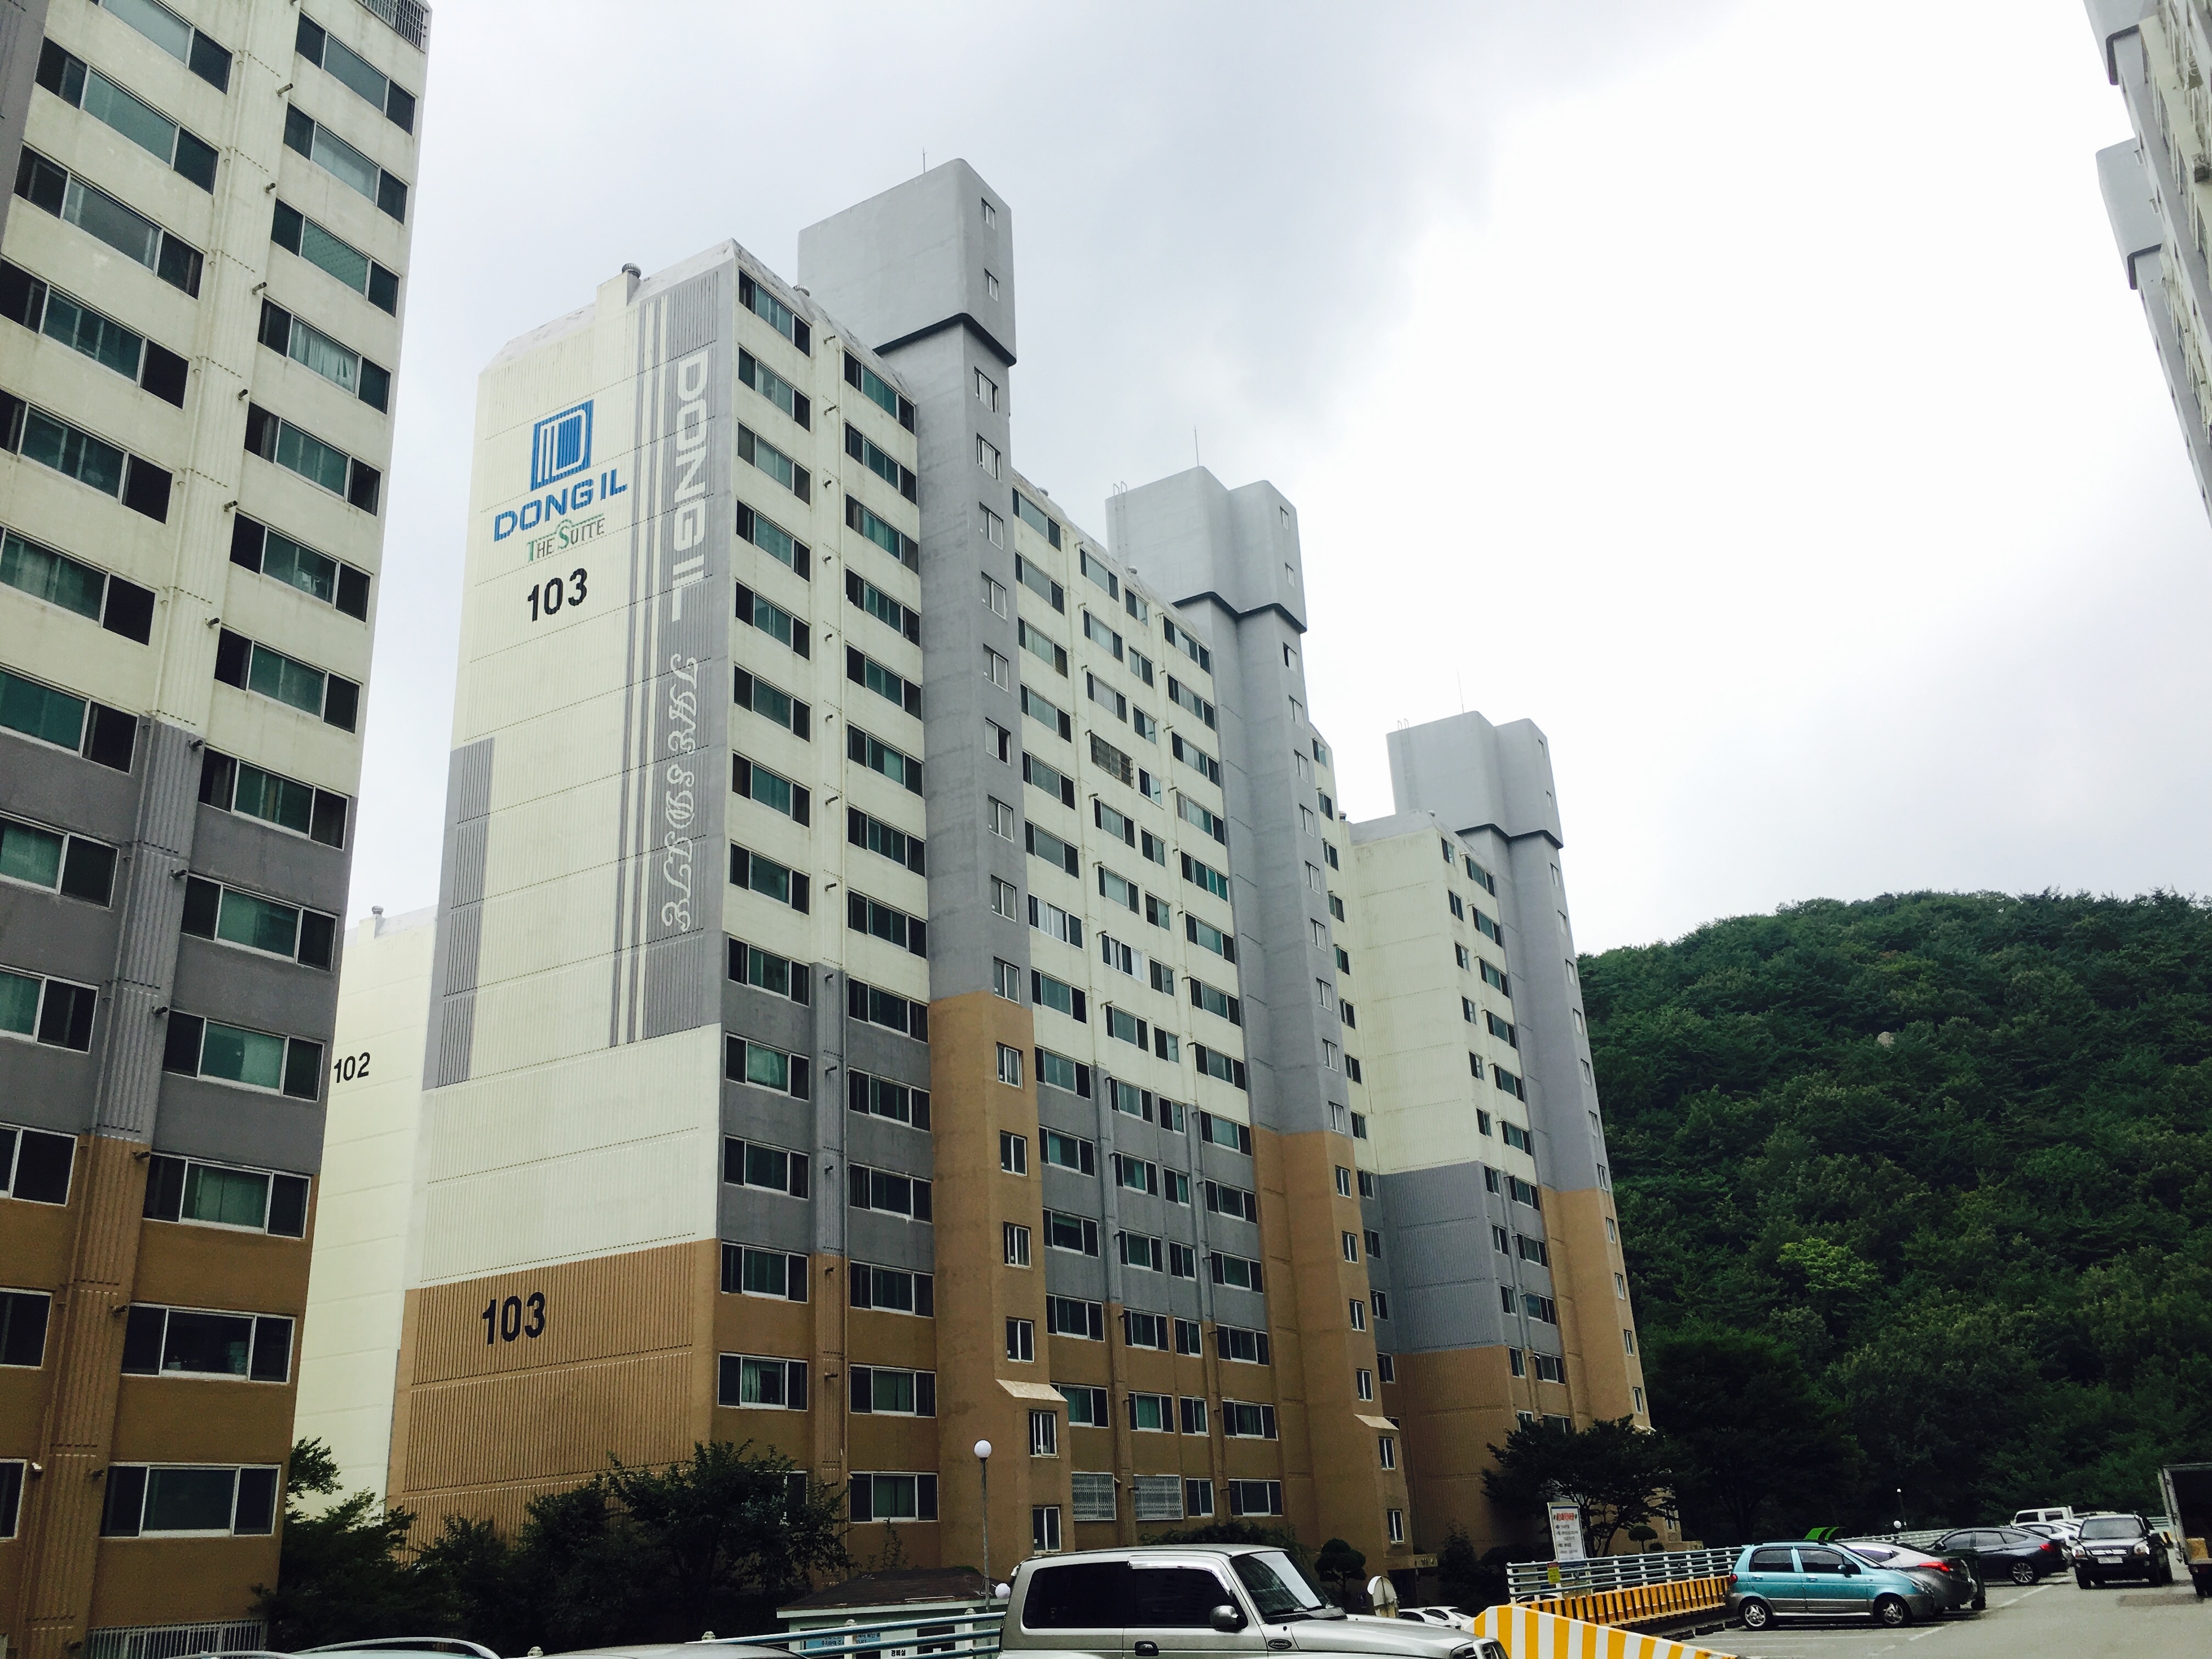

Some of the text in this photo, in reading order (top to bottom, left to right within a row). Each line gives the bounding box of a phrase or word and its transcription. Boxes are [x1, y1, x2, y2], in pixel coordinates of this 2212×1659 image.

[527, 517, 605, 563] THE SUITE
[527, 568, 588, 622] 103
[334, 1052, 370, 1084] 102
[482, 1291, 545, 1346] 103
